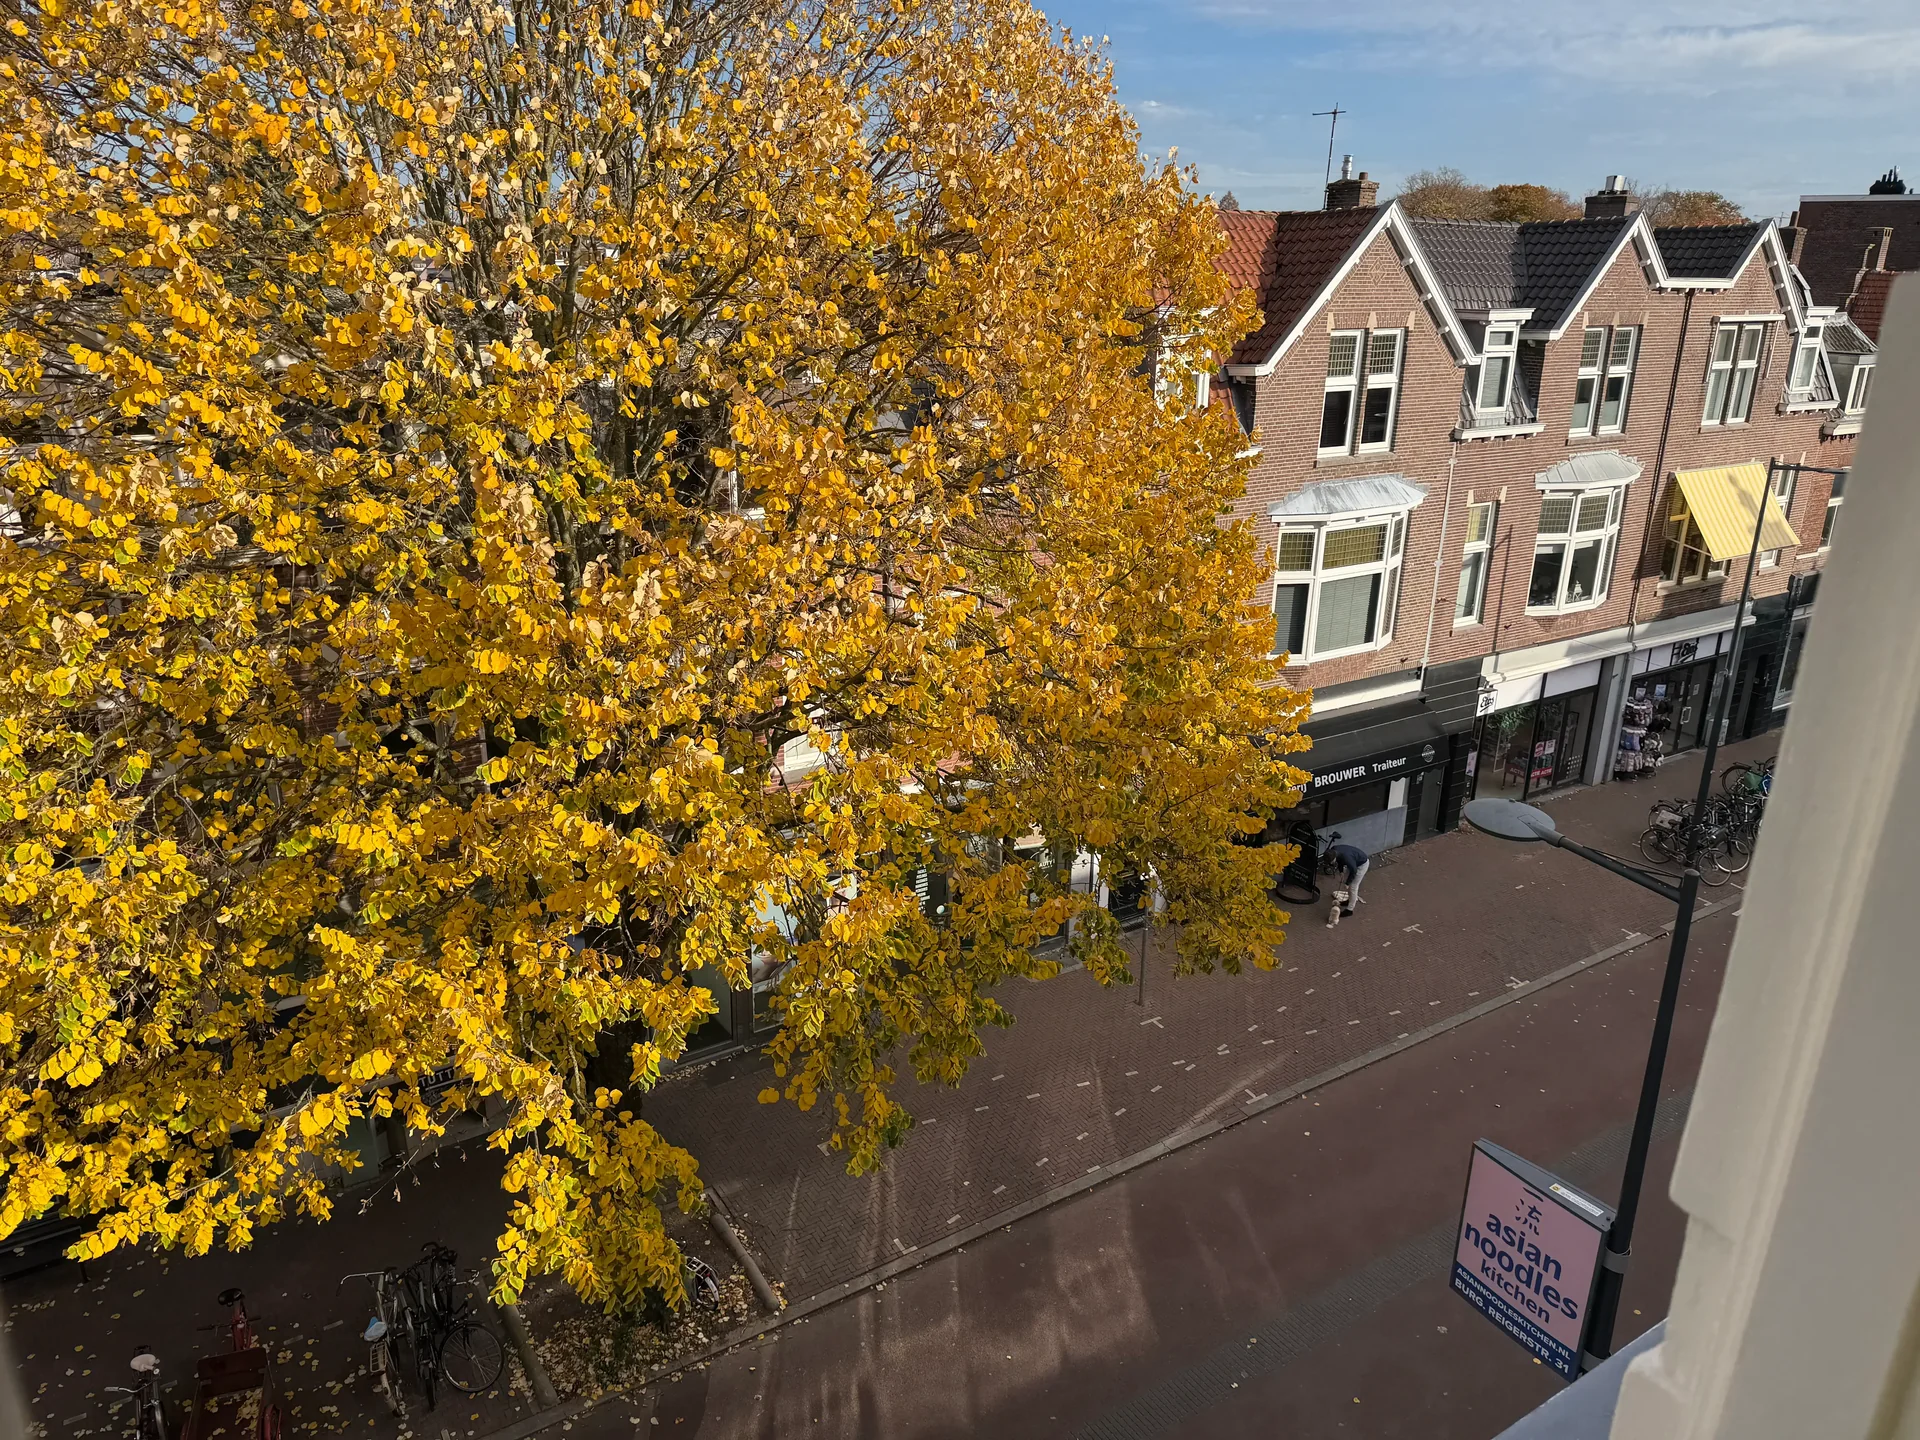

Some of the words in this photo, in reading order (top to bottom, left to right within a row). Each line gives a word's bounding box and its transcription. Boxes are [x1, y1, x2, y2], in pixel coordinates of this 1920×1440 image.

[1480, 696, 1495, 710] Etos
[1314, 766, 1366, 788] BROUWER
[1372, 757, 1407, 773] Traiteur
[418, 1068, 453, 1087] TUTT
[1464, 1222, 1578, 1320] noodles
[1486, 1213, 1562, 1281] asian
[1456, 1267, 1571, 1360] ASIANNOODLESKITCHEN.NL
[1481, 1258, 1551, 1324] kitchen
[1454, 1277, 1486, 1310] BURG.
[1488, 1305, 1552, 1362] REIGERSTR.
[1554, 1358, 1569, 1374] 31
